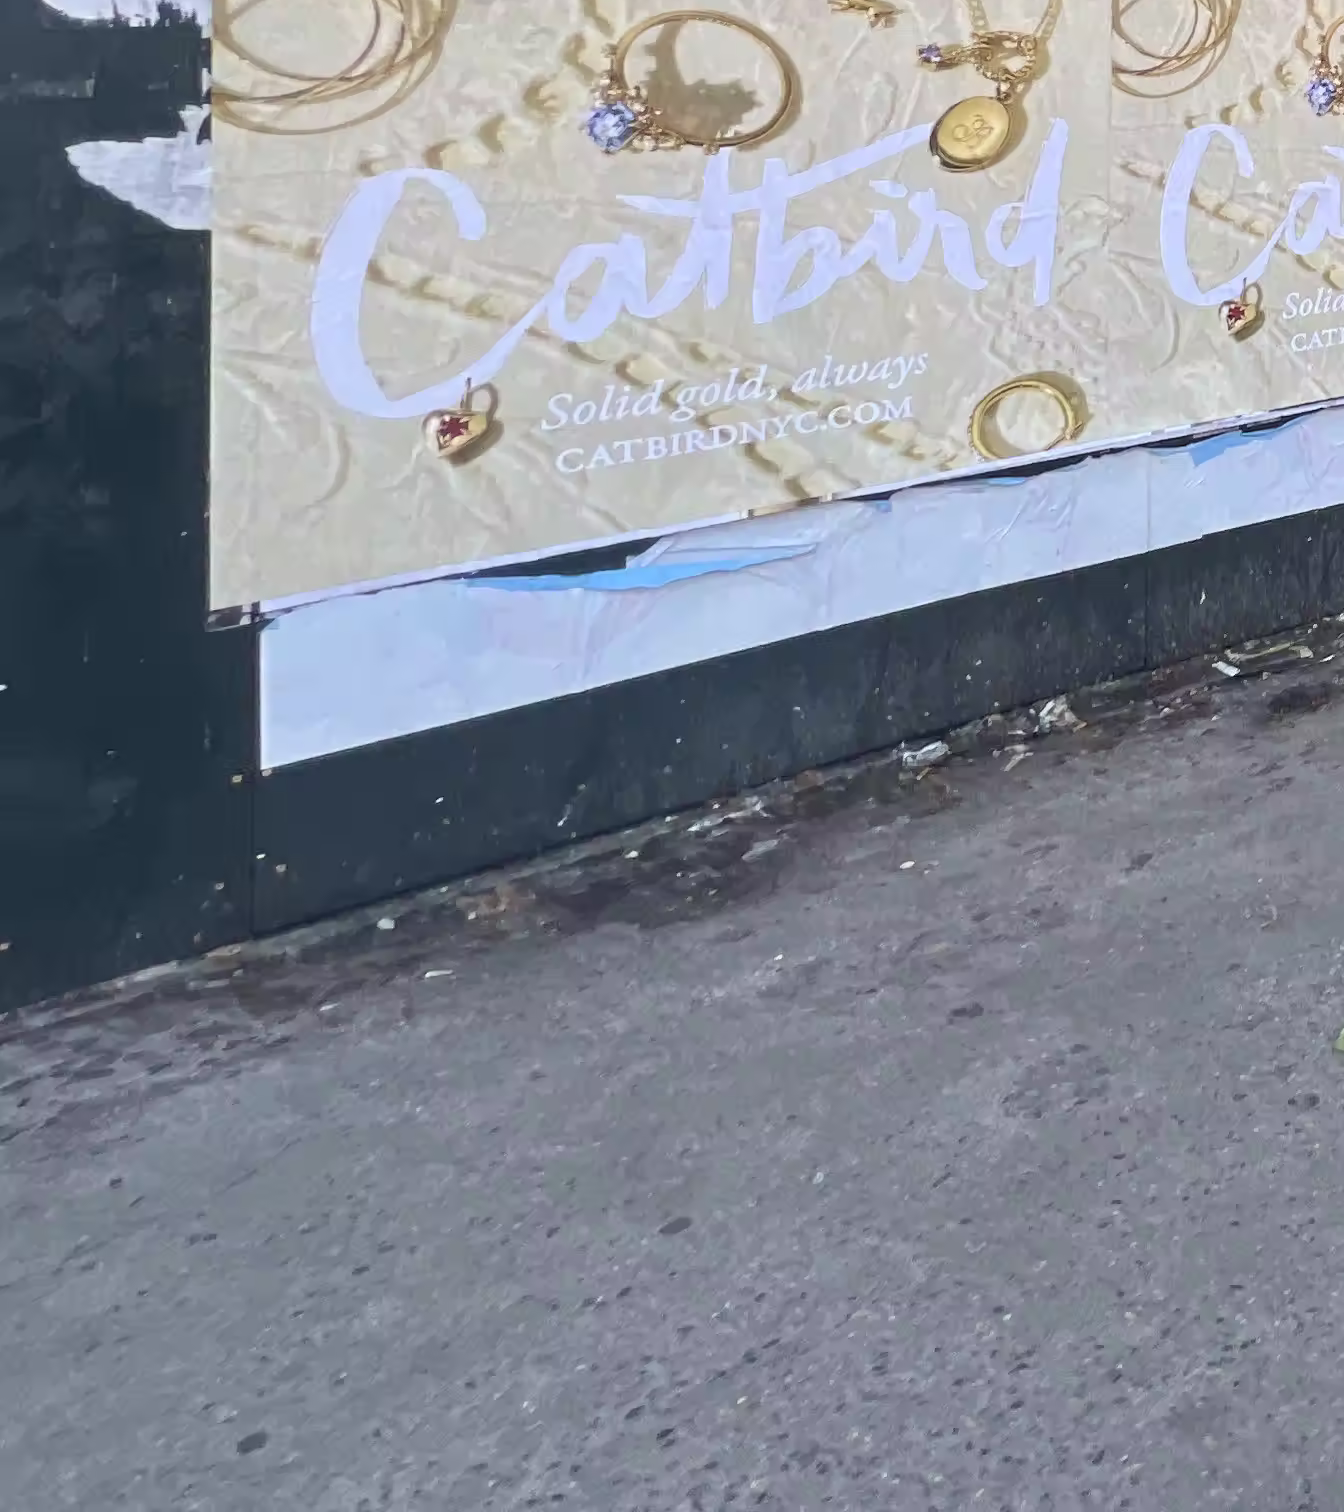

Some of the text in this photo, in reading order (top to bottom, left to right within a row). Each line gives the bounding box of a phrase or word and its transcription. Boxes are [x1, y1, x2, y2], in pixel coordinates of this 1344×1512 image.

[309, 117, 1070, 420] Catbird
[541, 352, 929, 431] Solid gold, always
[554, 395, 915, 475] CATBIRDNYC.COM
